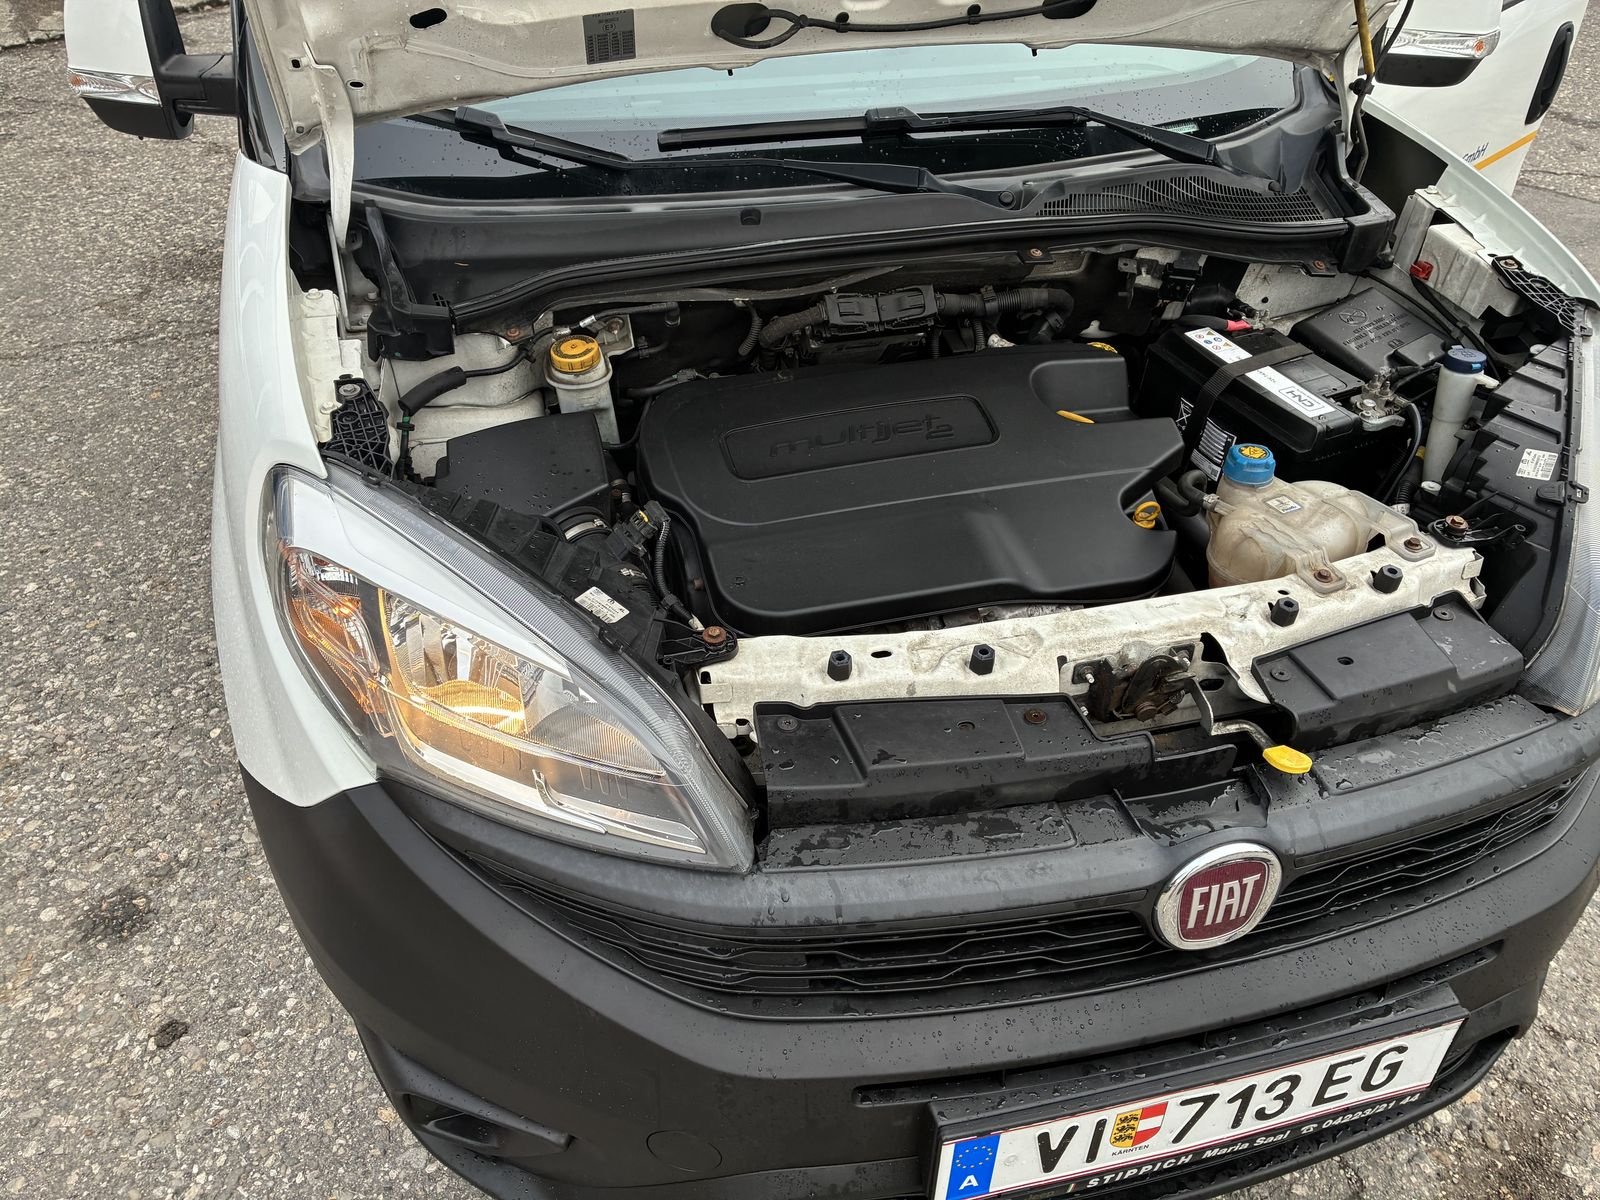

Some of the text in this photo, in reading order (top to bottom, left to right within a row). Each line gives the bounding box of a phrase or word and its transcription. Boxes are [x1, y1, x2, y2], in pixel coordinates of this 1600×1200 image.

[1186, 873, 1262, 929] FIAT
[1036, 1044, 1409, 1174] VI 713 EG
[1086, 1153, 1193, 1189] STIPPICH
[1202, 1141, 1250, 1160] Maria
[1253, 1130, 1291, 1147] Saal
[1111, 1144, 1150, 1157] KÄRNTEN
[958, 1174, 979, 1191] A
